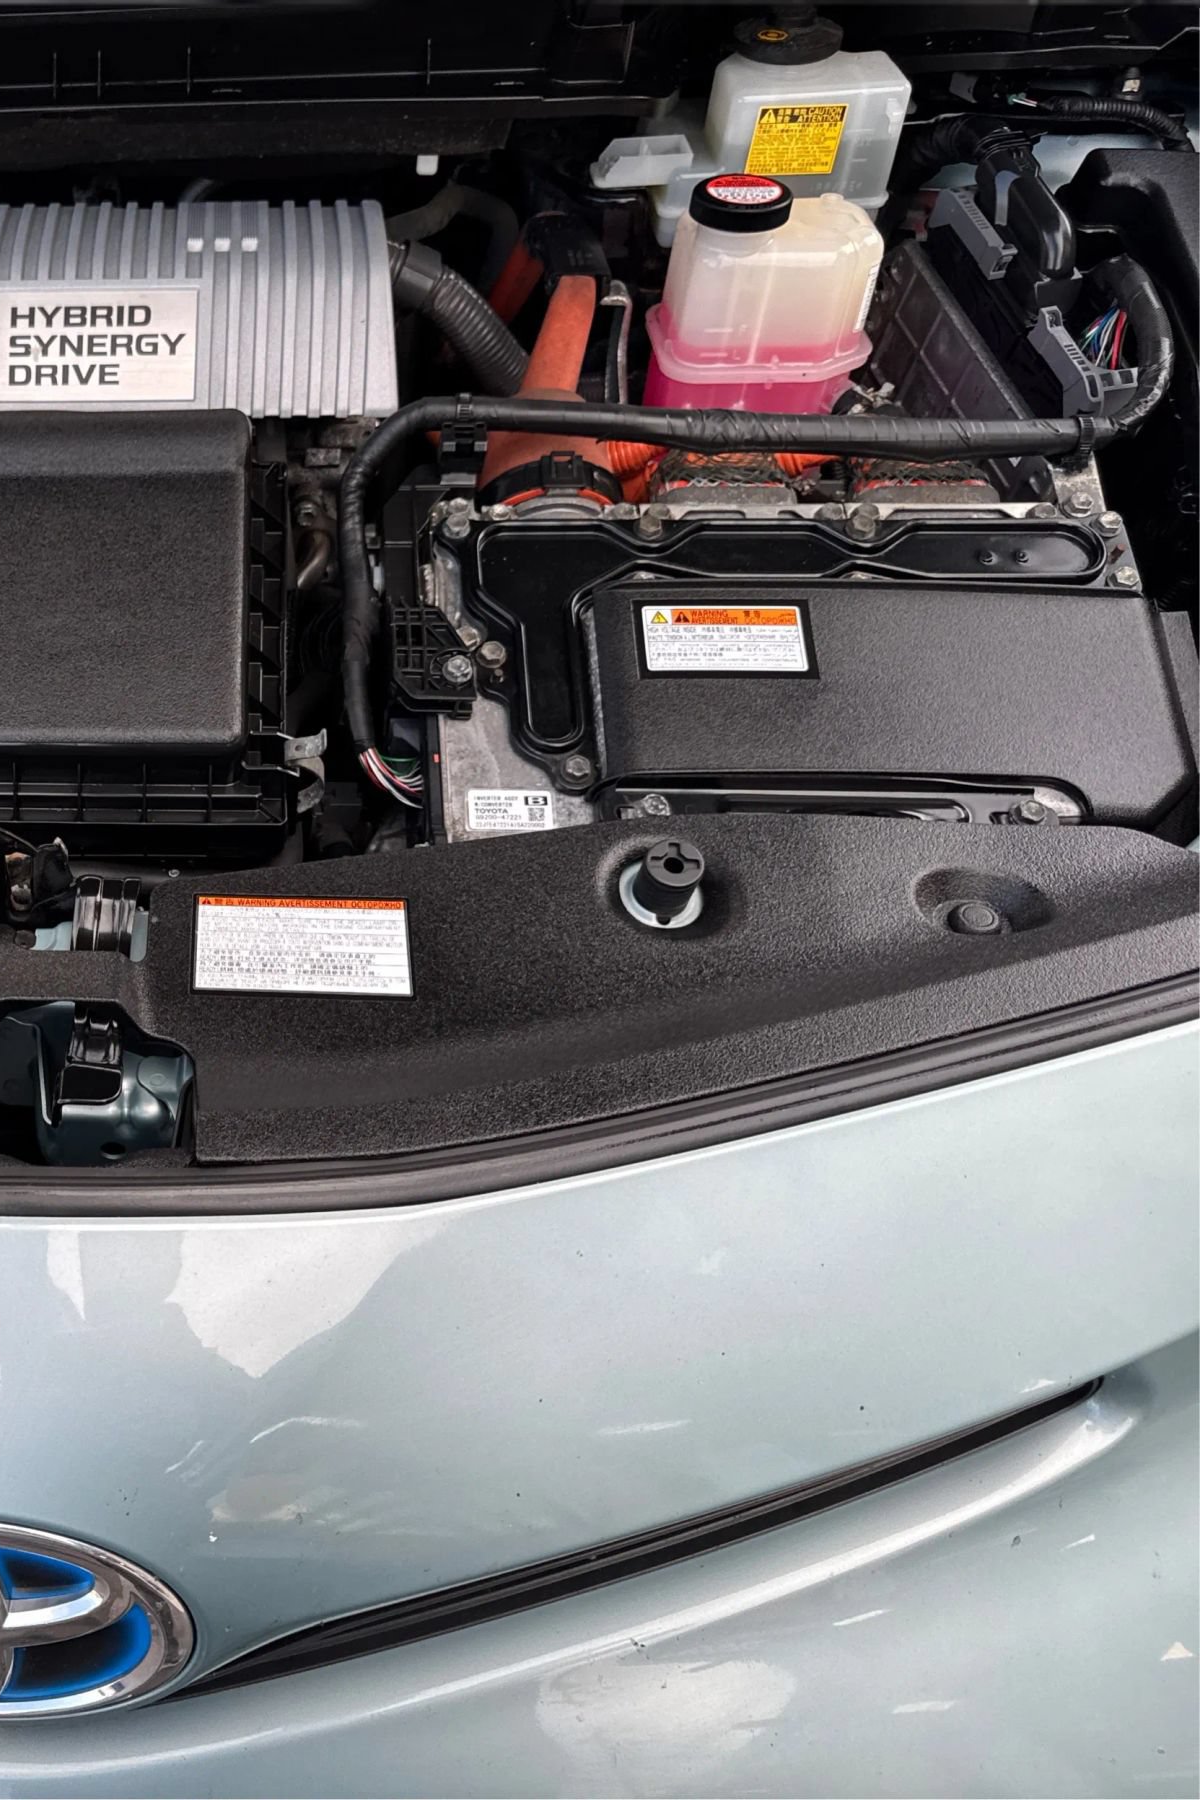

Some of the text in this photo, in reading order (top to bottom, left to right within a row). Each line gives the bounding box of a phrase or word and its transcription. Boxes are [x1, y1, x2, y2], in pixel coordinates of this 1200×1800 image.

[797, 114, 841, 122] ATTENTION
[808, 107, 843, 115] CAUTION
[10, 305, 152, 328] HYBRID
[8, 333, 187, 357] SYNERGY
[8, 364, 120, 386] DRIVE
[279, 900, 347, 908] AVERTISSEMENT
